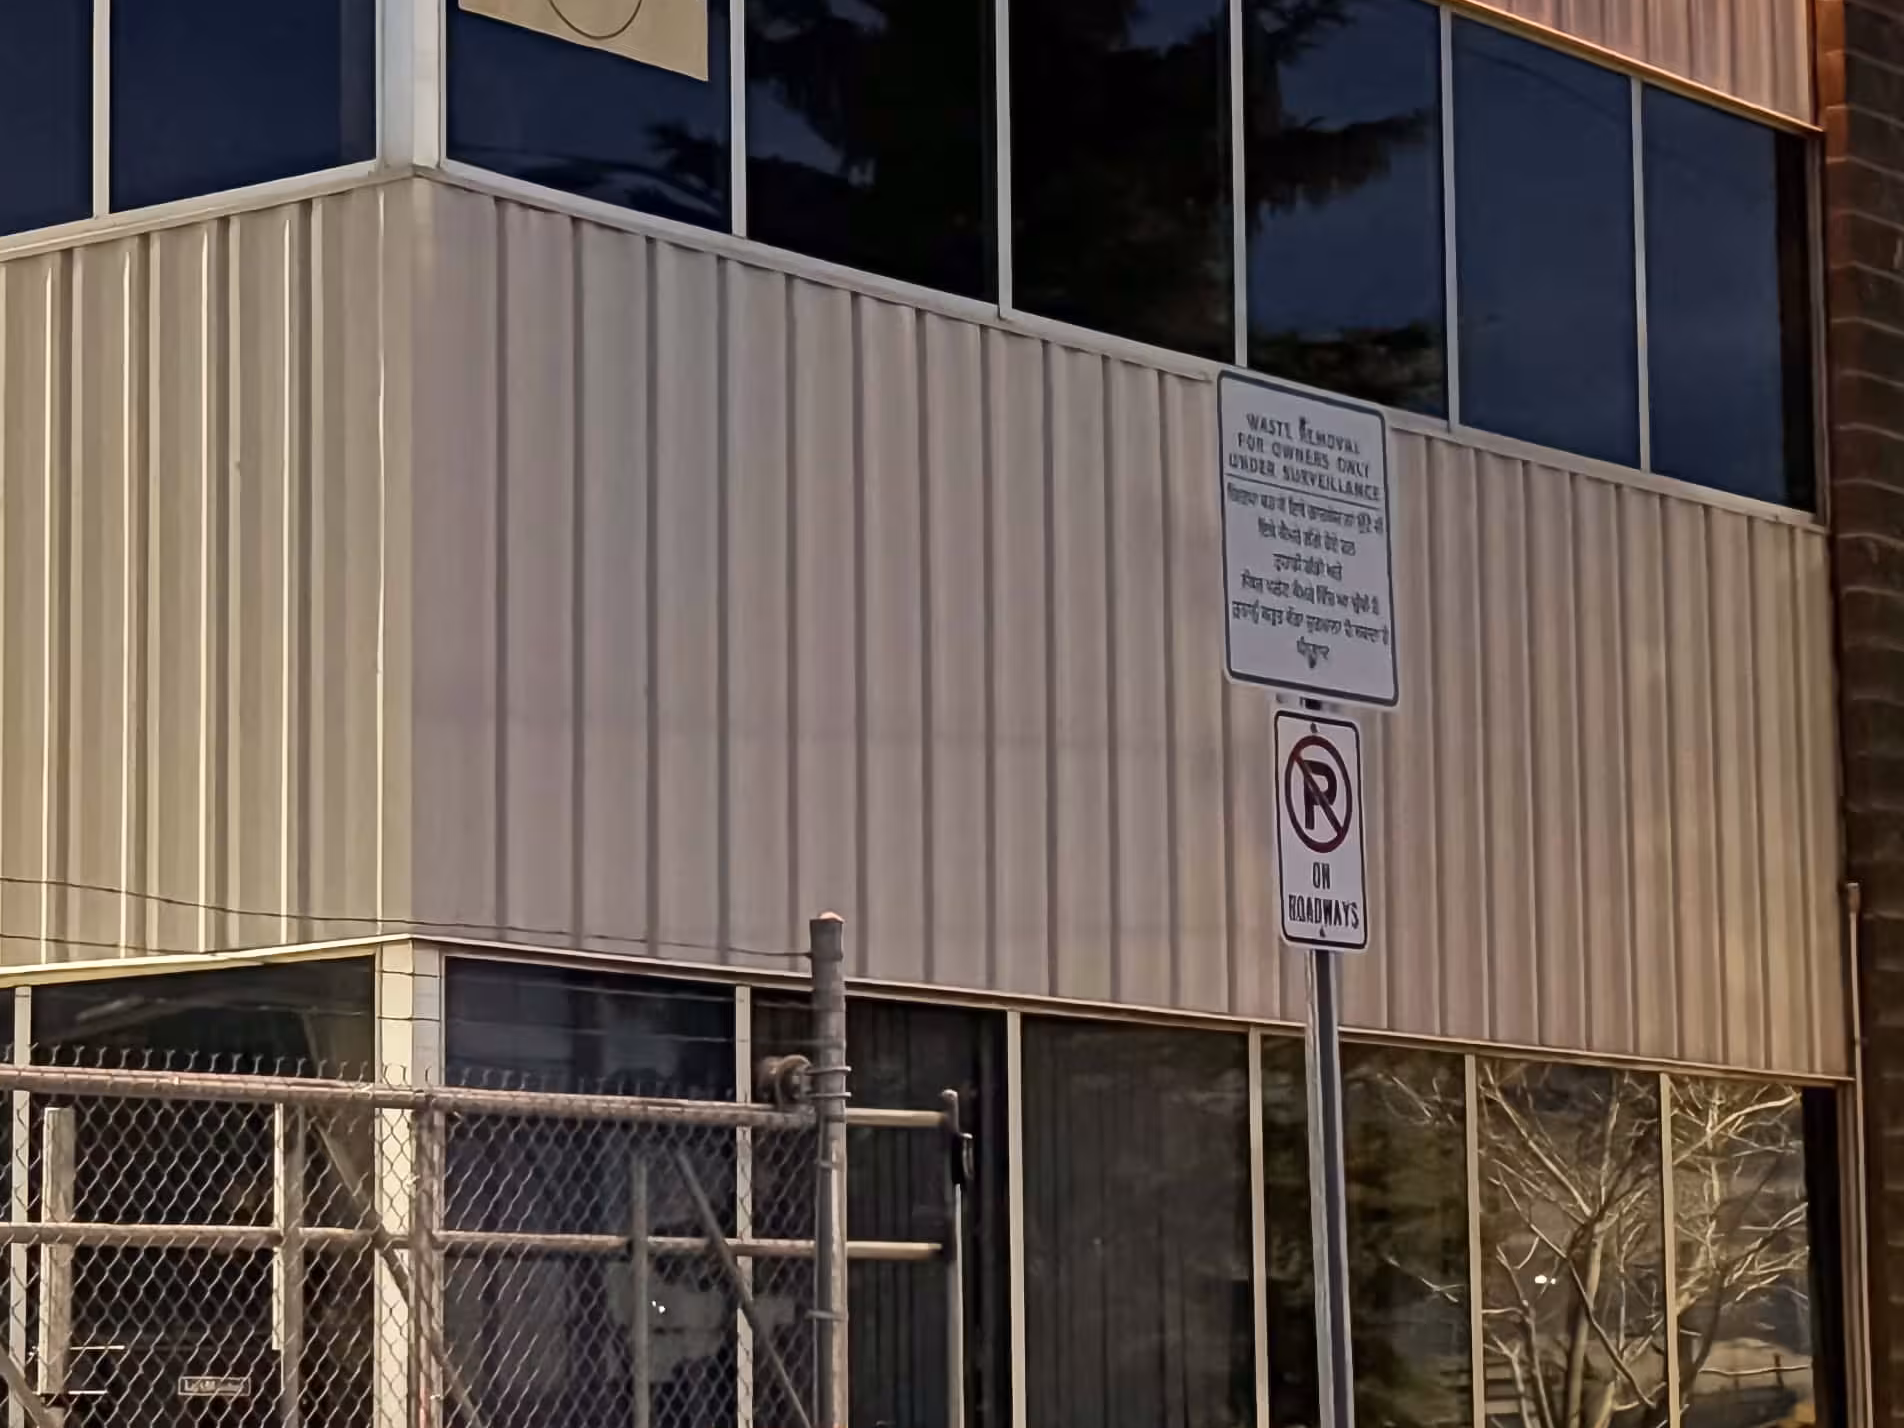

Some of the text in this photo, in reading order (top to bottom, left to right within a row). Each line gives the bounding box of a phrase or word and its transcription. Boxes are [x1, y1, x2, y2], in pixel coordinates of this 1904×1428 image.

[1246, 413, 1361, 455] WASTE REMOVAL
[1238, 432, 1370, 479] FOR OWNERS ONLY
[1229, 453, 1381, 502] UNDER SURVEILLANCE
[1312, 861, 1331, 890] ON
[1288, 893, 1360, 930] ROADWAYS
